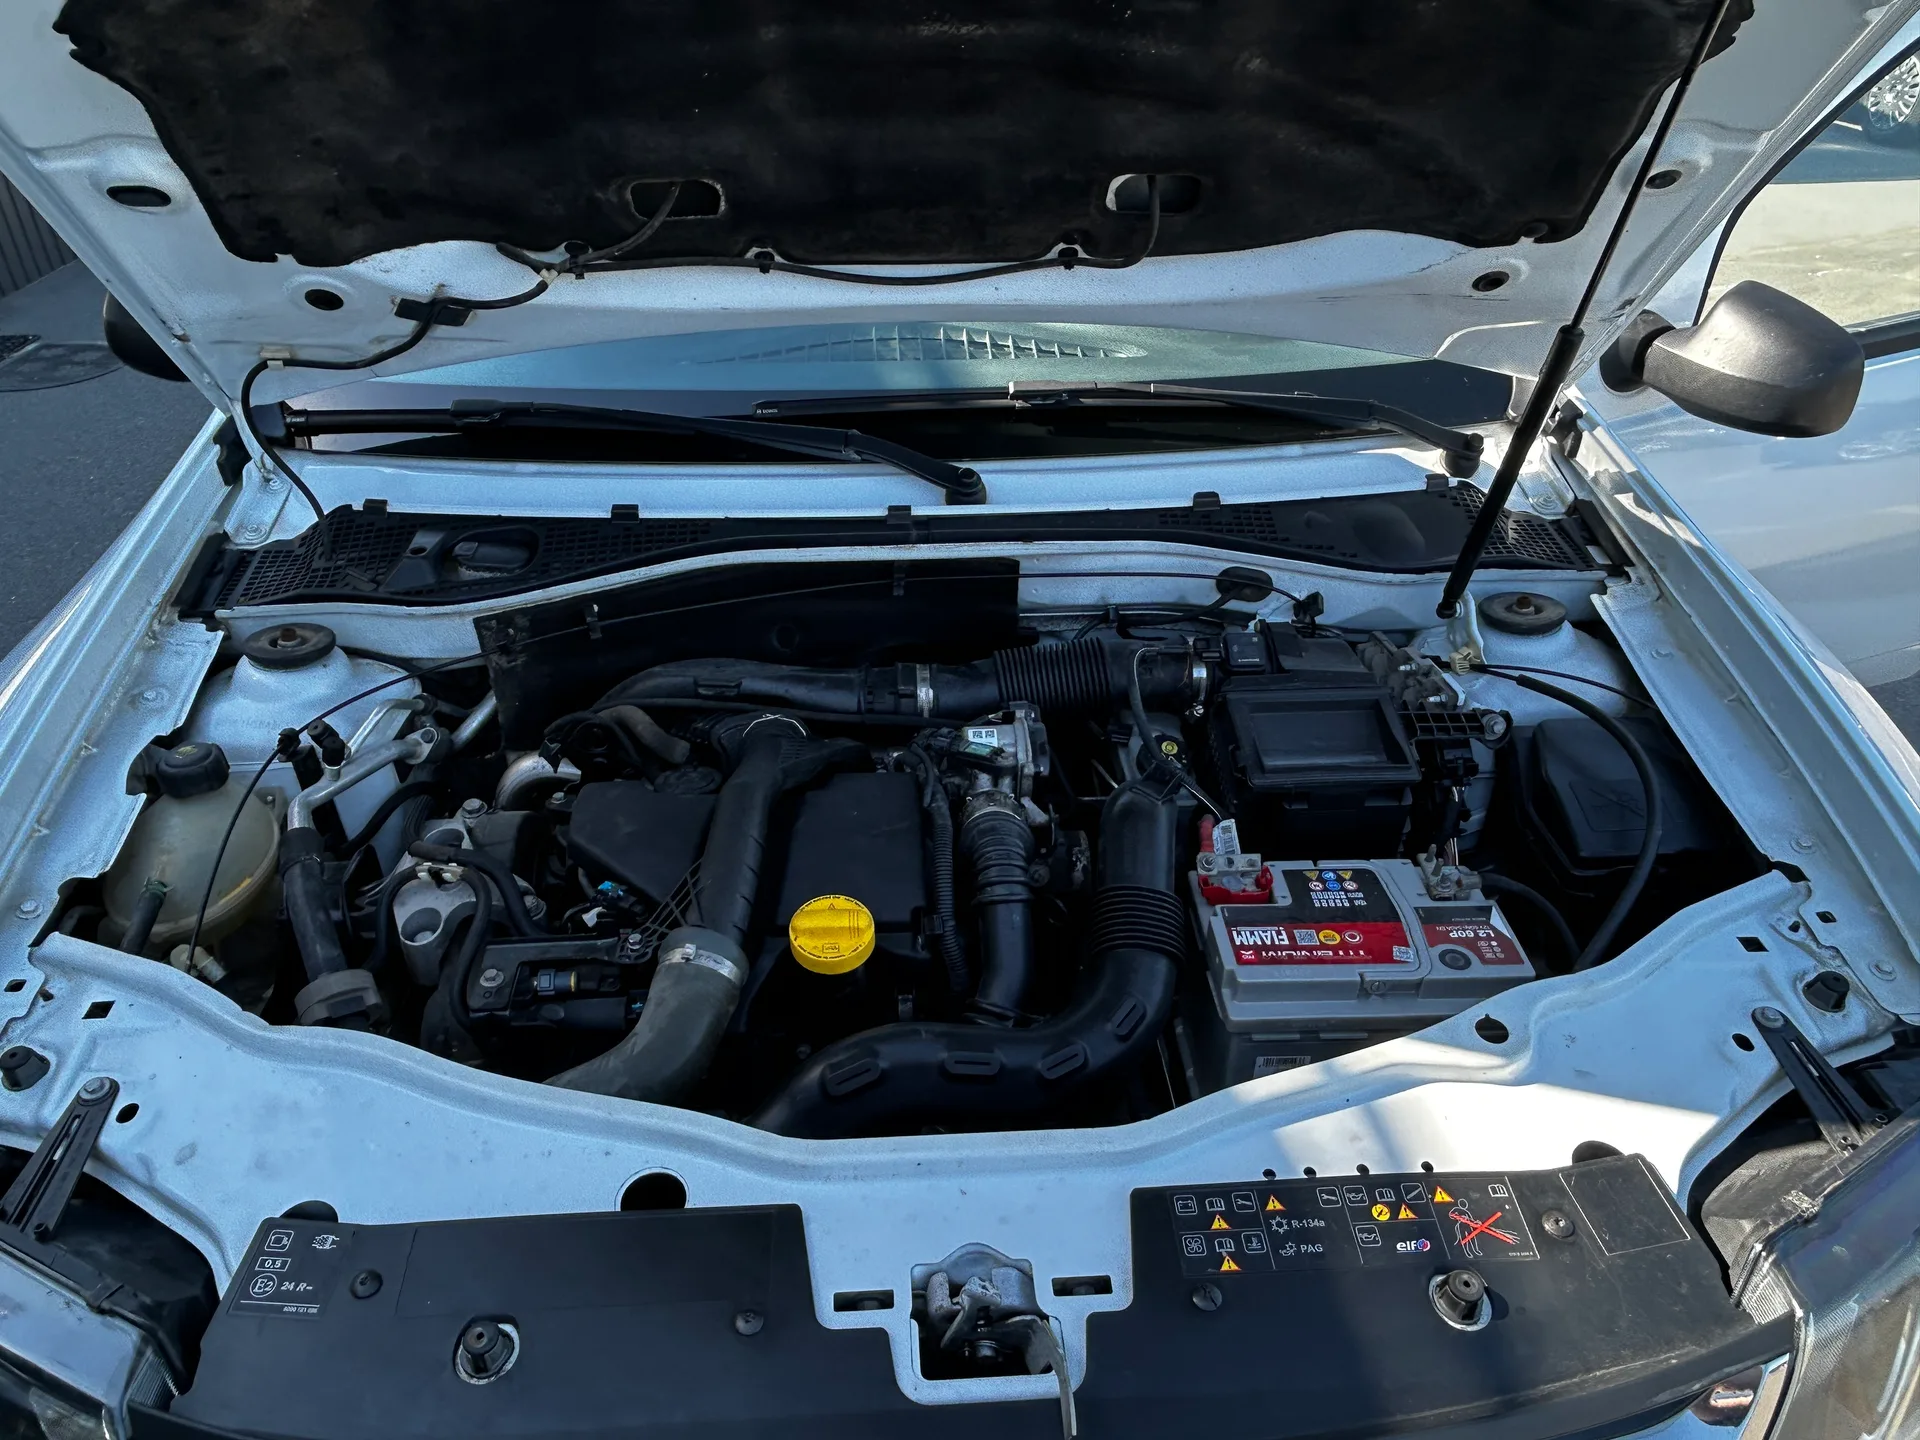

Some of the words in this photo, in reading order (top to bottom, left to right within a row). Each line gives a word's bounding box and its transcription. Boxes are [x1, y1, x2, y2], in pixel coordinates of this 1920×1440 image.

[1231, 930, 1290, 946] FIAMM
[1476, 929, 1495, 938] L2
[1291, 1218, 1326, 1229] R-134a
[1300, 1243, 1323, 1253] PAG
[1396, 1240, 1417, 1252] elf
[252, 1278, 274, 1293] E2
[280, 1281, 295, 1291] 24
